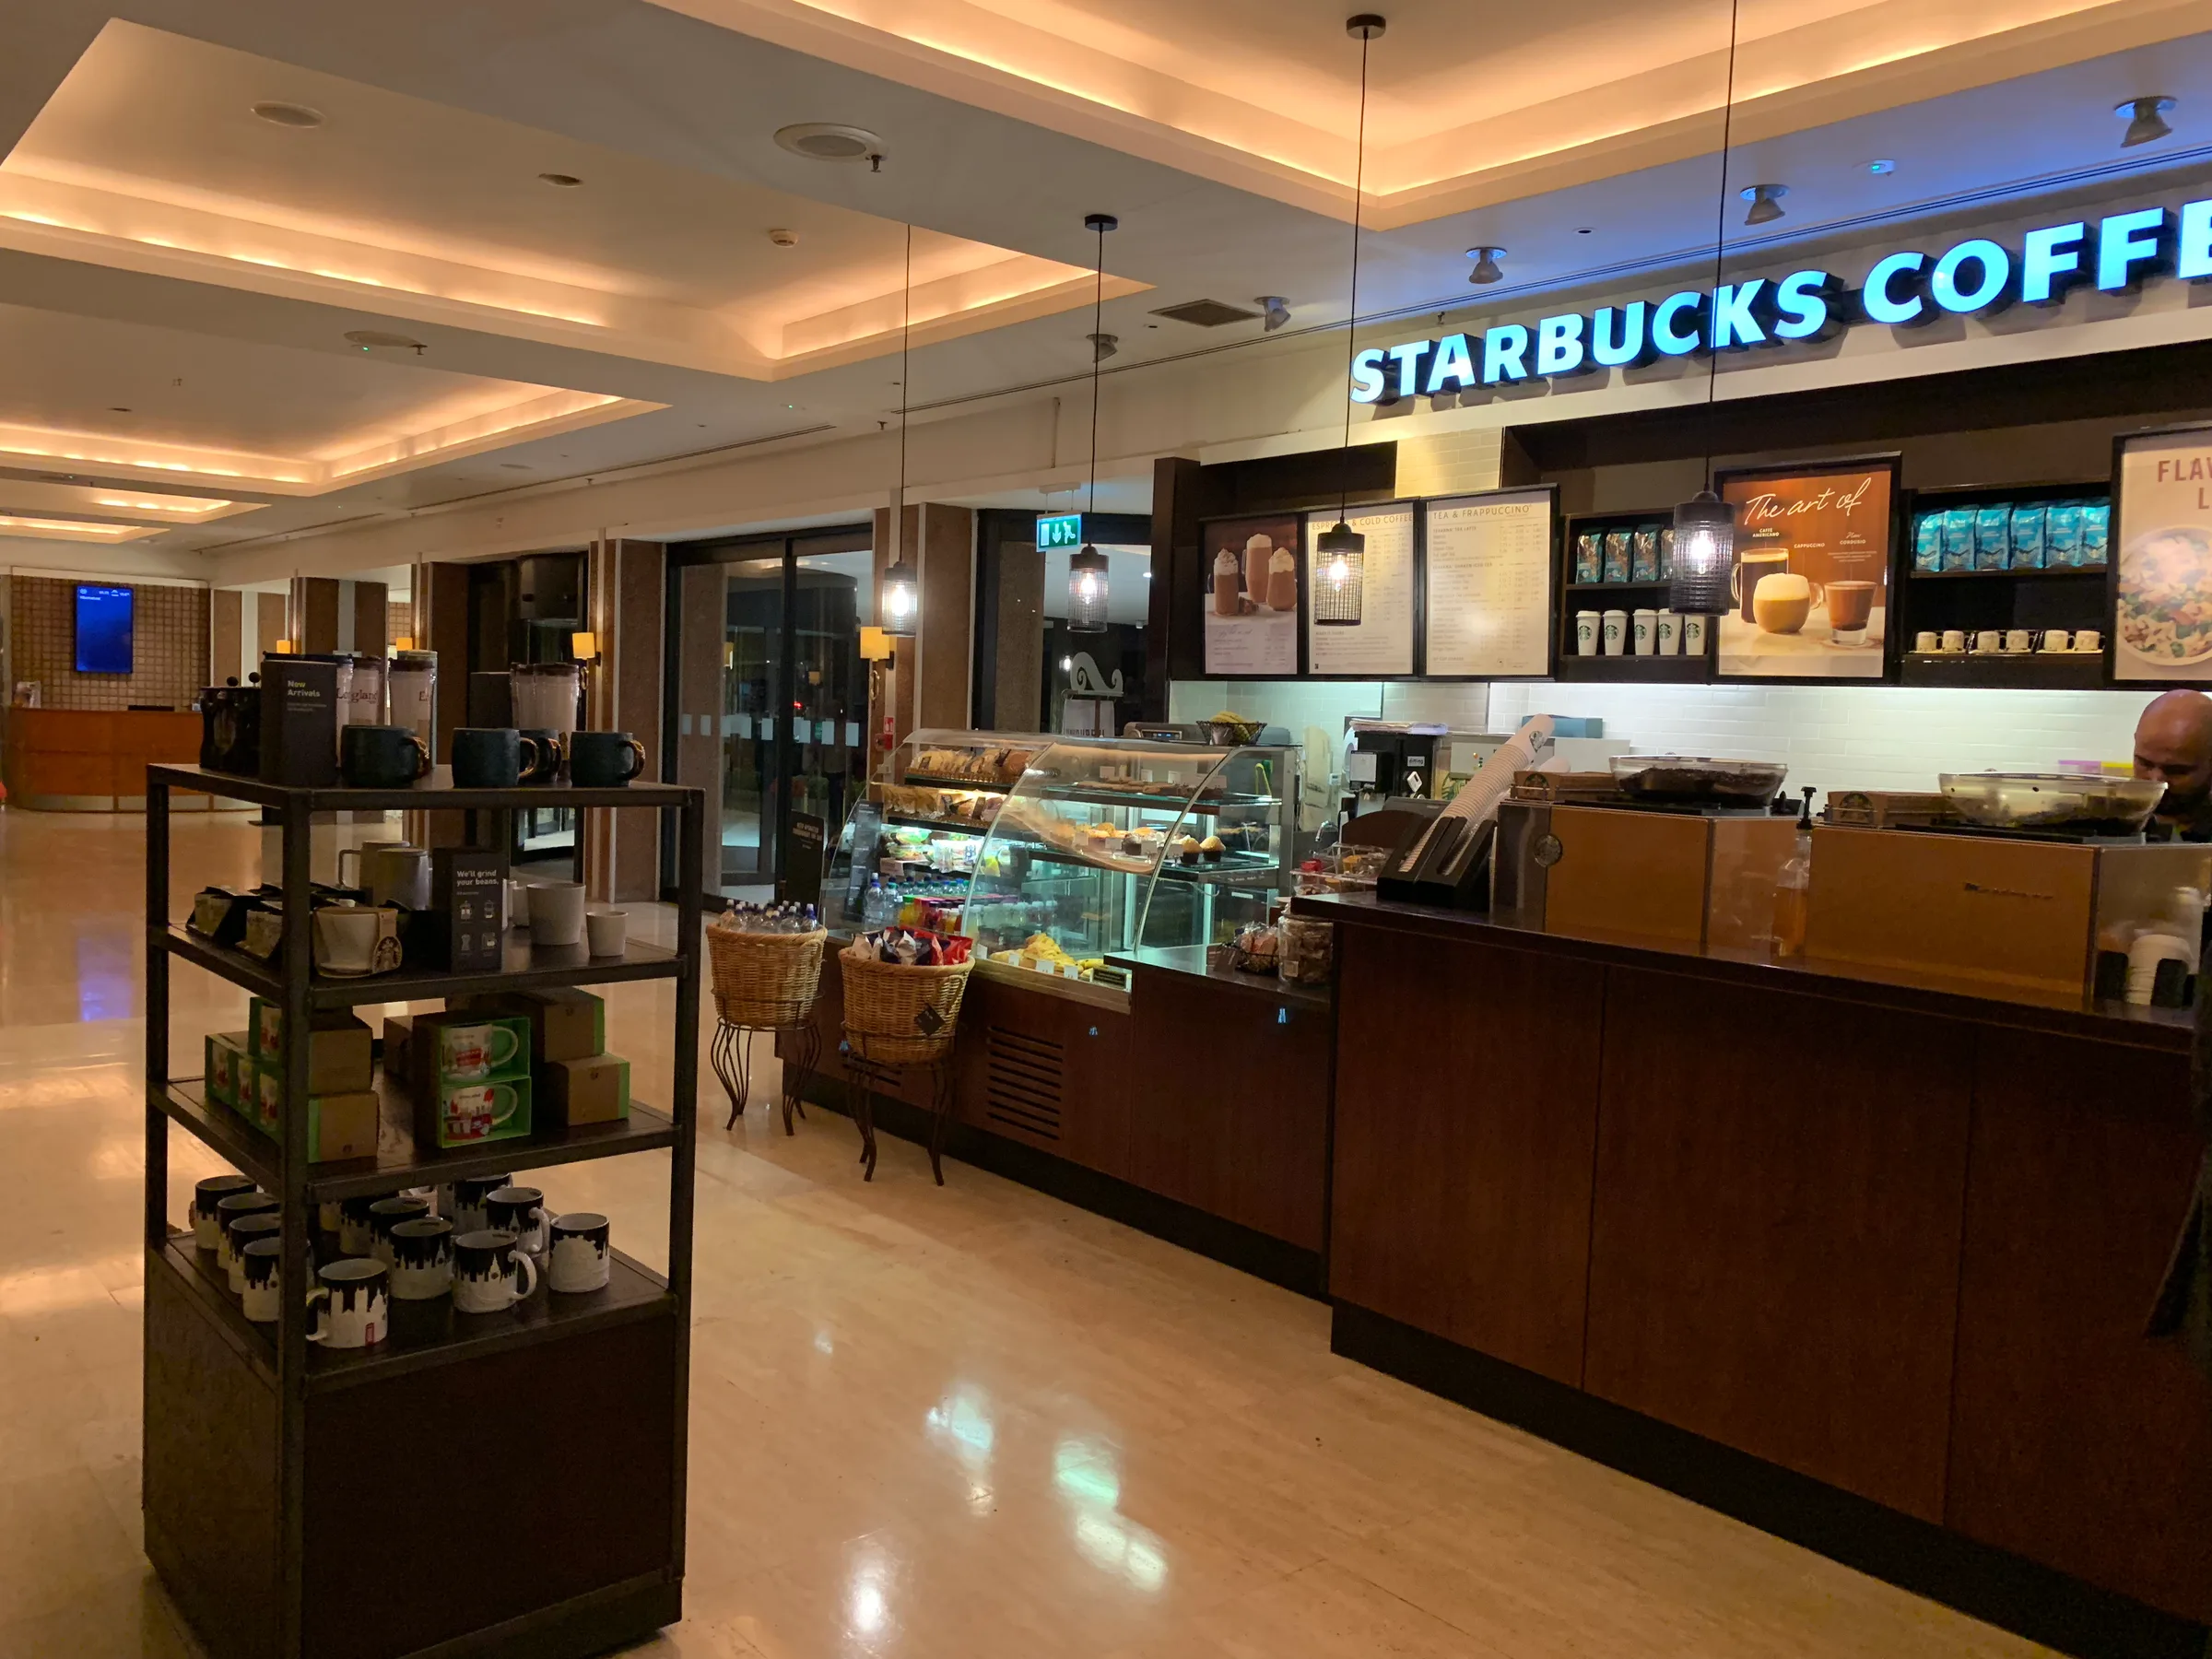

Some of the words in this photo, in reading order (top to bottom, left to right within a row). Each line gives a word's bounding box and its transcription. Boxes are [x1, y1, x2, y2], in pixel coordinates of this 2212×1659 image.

[1350, 270, 1827, 403] STARBUCKS
[1745, 493, 1784, 525] The
[1787, 488, 1835, 516] art
[1836, 477, 1871, 516] of
[1359, 517, 1381, 526] COLD
[1383, 513, 1413, 524] COFFEE
[1433, 511, 1449, 519] TEA
[288, 689, 321, 698] Arrivals
[477, 869, 497, 877] grind
[456, 879, 473, 888] your
